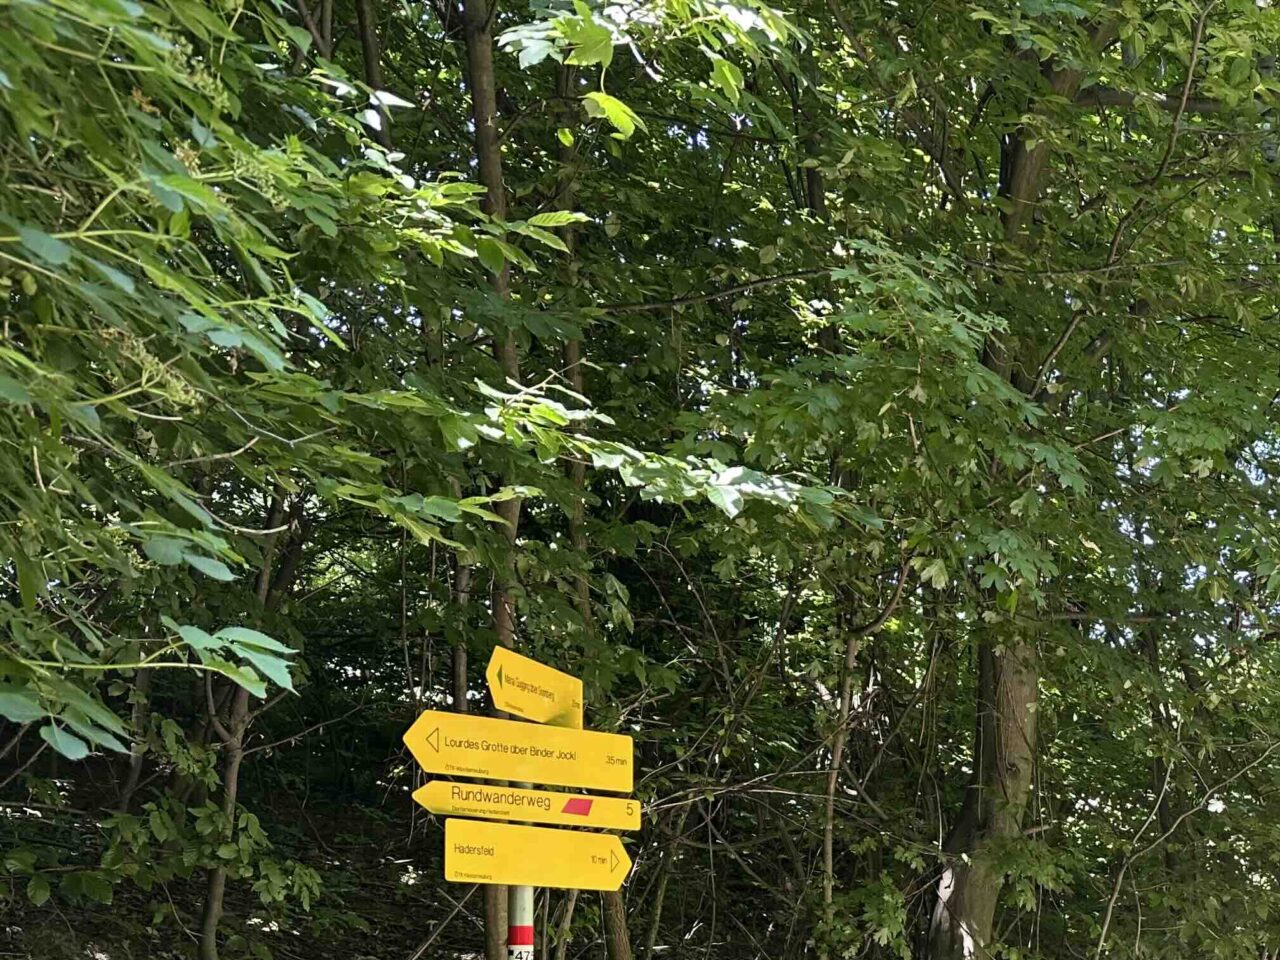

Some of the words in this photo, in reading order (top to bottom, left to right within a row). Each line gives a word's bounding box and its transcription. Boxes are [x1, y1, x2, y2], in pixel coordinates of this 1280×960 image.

[445, 736, 480, 751] Lourdes
[481, 740, 509, 753] Grotte
[510, 744, 528, 756] über
[530, 746, 555, 758] Binder
[556, 750, 577, 761] Jockl
[605, 755, 615, 765] 35
[615, 758, 628, 766] min
[451, 785, 551, 811] Rundwanderweg
[626, 803, 634, 816] 5
[454, 843, 495, 857] Hadersfeld
